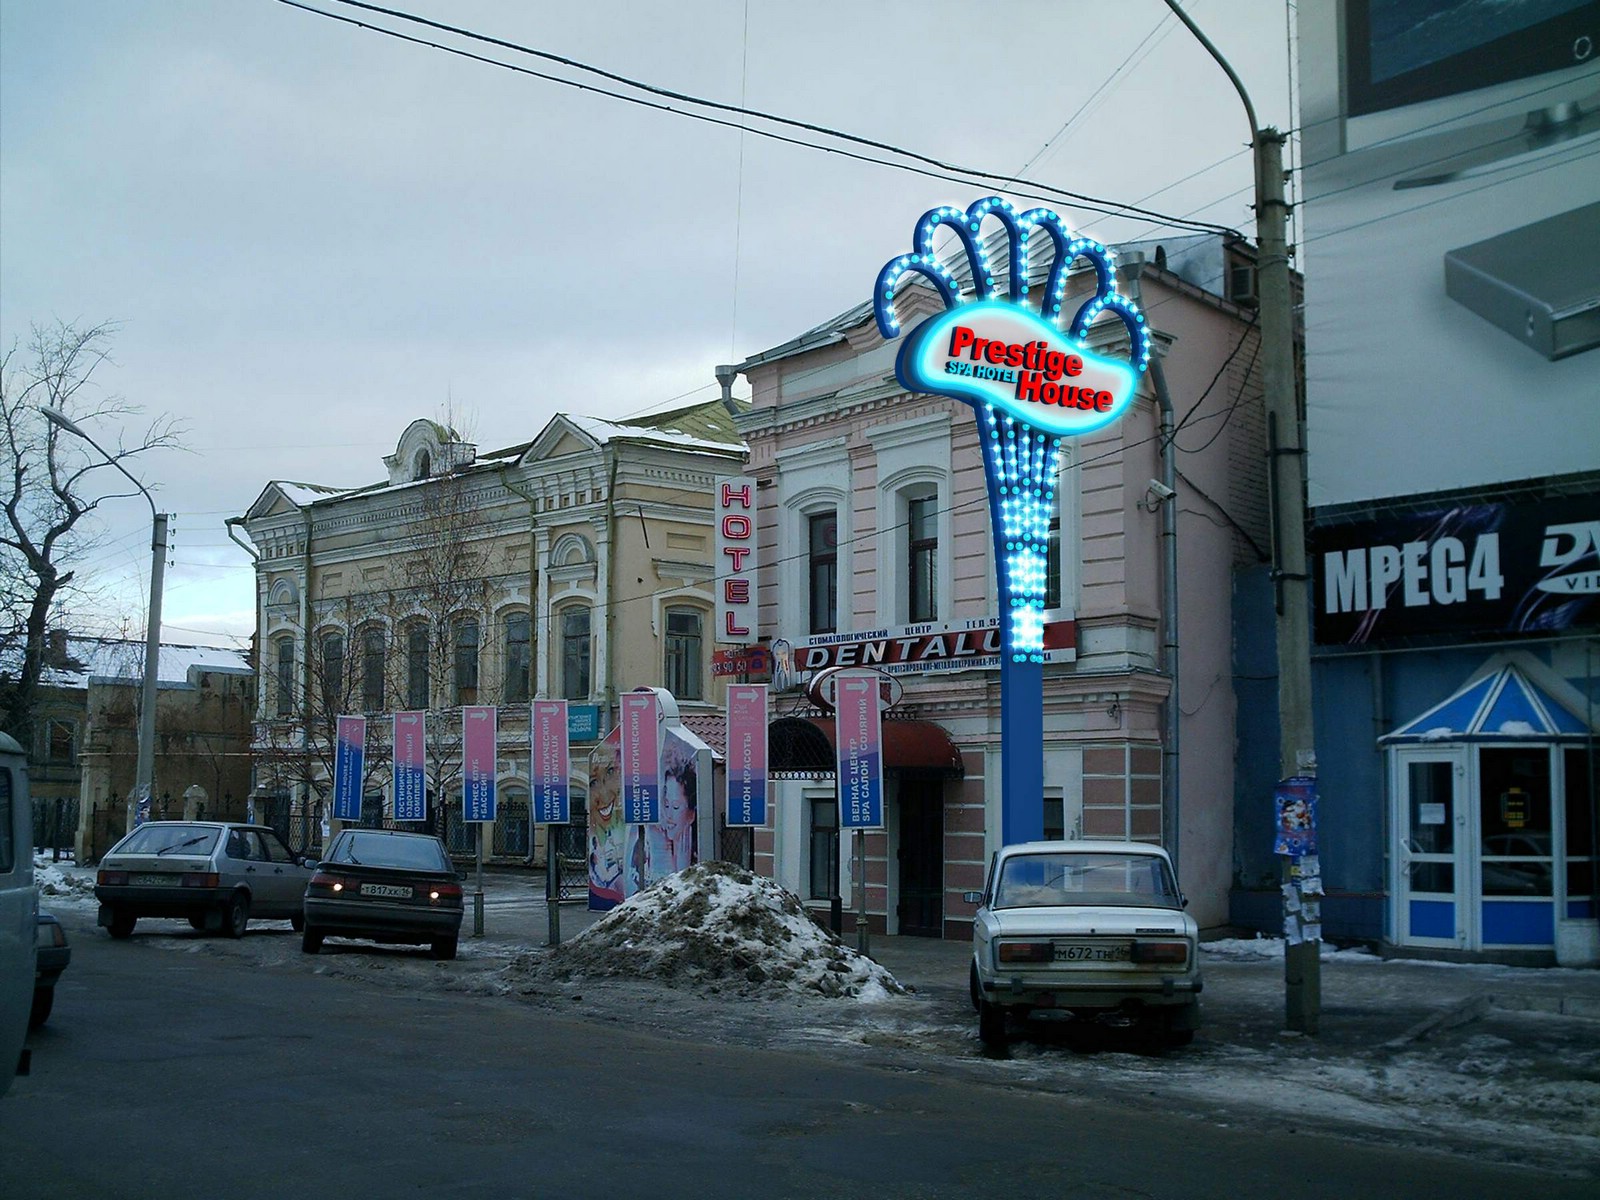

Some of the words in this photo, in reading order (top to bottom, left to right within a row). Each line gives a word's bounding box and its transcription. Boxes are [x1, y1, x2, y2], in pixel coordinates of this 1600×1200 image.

[945, 360, 974, 378] SPA
[974, 365, 1018, 384] HOTEL
[948, 326, 1083, 381] Prestige
[1015, 370, 1114, 413] House
[721, 483, 752, 637] HOTEL
[1324, 532, 1504, 614] MPEG4
[808, 629, 888, 645] СТОМАТОЛОГИЧЕСКИЙ
[905, 625, 932, 635] ЦЕНТР
[859, 698, 868, 751] СОЛЯРИЙ
[543, 716, 551, 820] СТОМАТОЛОГИЧЕСКИЙ
[631, 711, 640, 821] КОСМЕТОЛОГИЧЕСКИЙ
[743, 732, 751, 784] КРАСОТЫ
[850, 738, 859, 776] ЦЕНТР
[861, 760, 870, 798] САЛОН
[552, 790, 560, 820] ЦЕНТР
[743, 786, 751, 823] САЛОН
[851, 777, 860, 822] ВЕЛНАС
[862, 801, 870, 822] SPA
